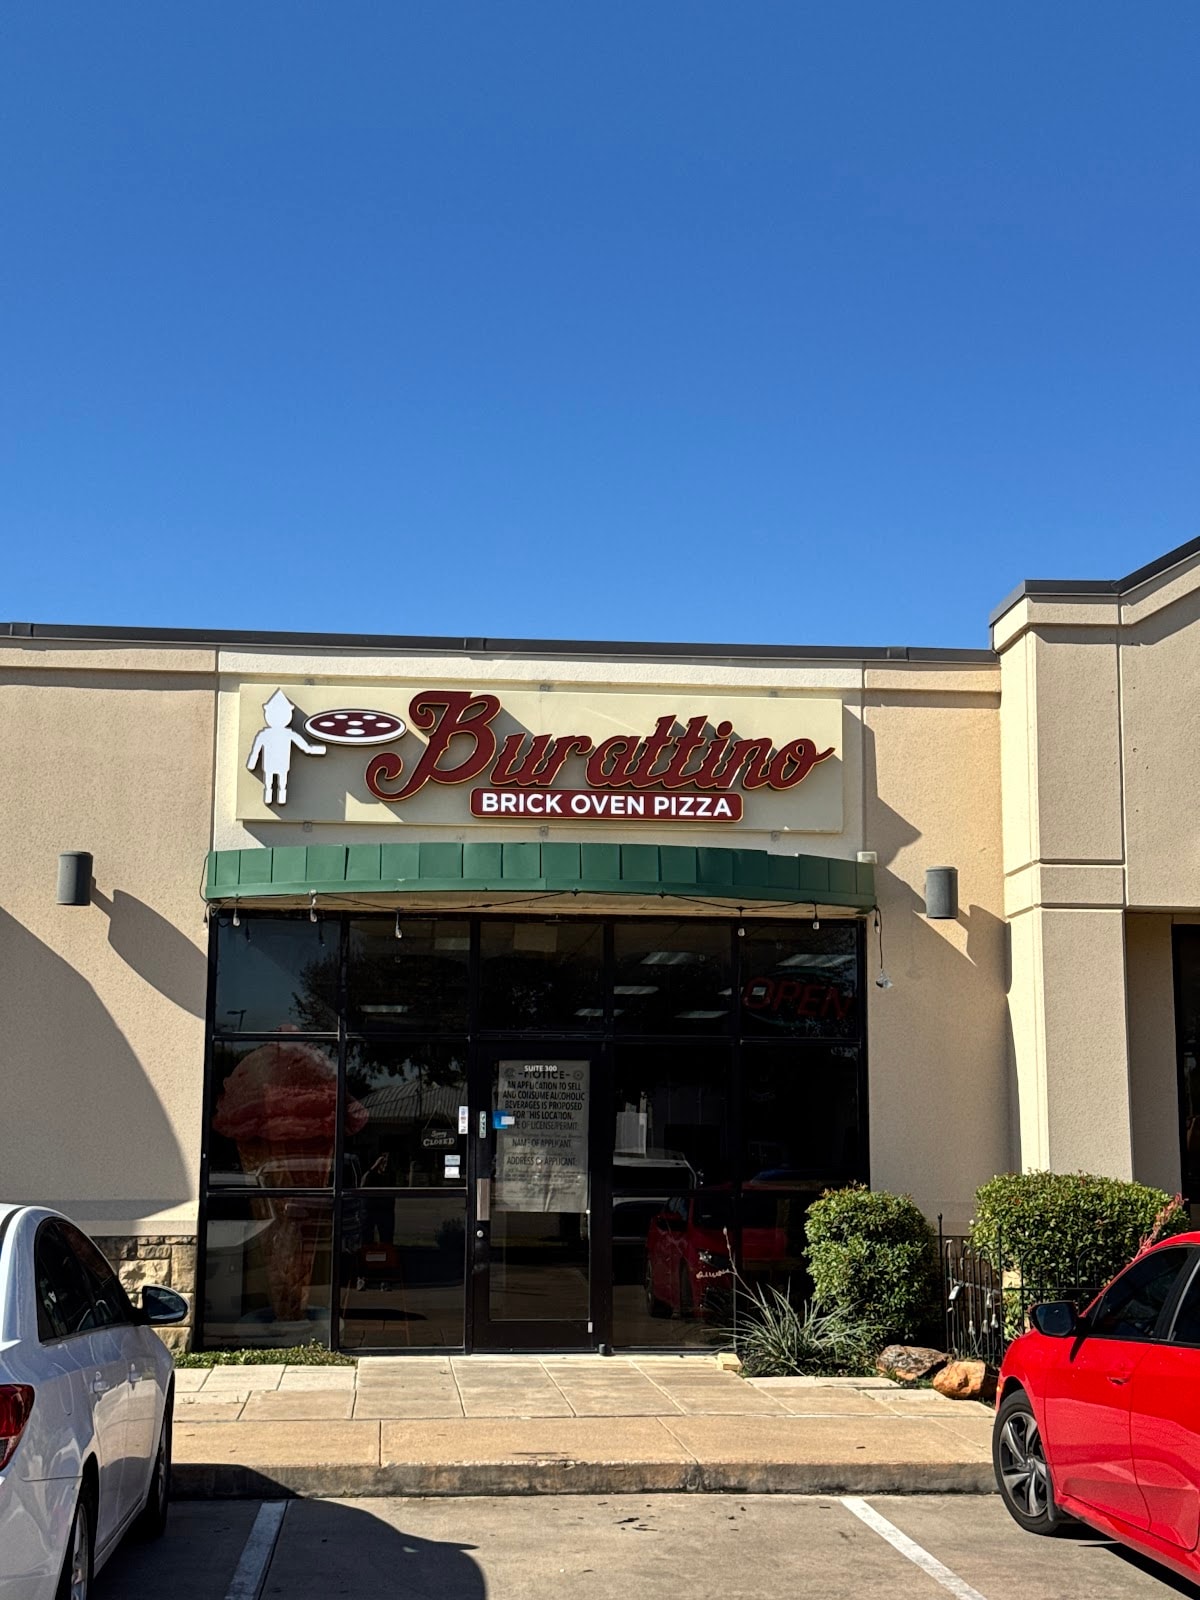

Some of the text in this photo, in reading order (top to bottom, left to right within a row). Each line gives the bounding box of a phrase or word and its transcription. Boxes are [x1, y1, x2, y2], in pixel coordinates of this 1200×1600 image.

[364, 690, 836, 801] Burattino
[482, 792, 733, 817] BRICK OVEN PIZZA
[742, 975, 857, 1021] OPEN
[517, 1081, 557, 1090] APPLICATION
[559, 1082, 567, 1091] TO
[568, 1082, 582, 1091] SELL
[503, 1091, 585, 1101] AND CONSUME ALCOHOLIC
[505, 1100, 583, 1110] BEVERAGES IS PROPOSED
